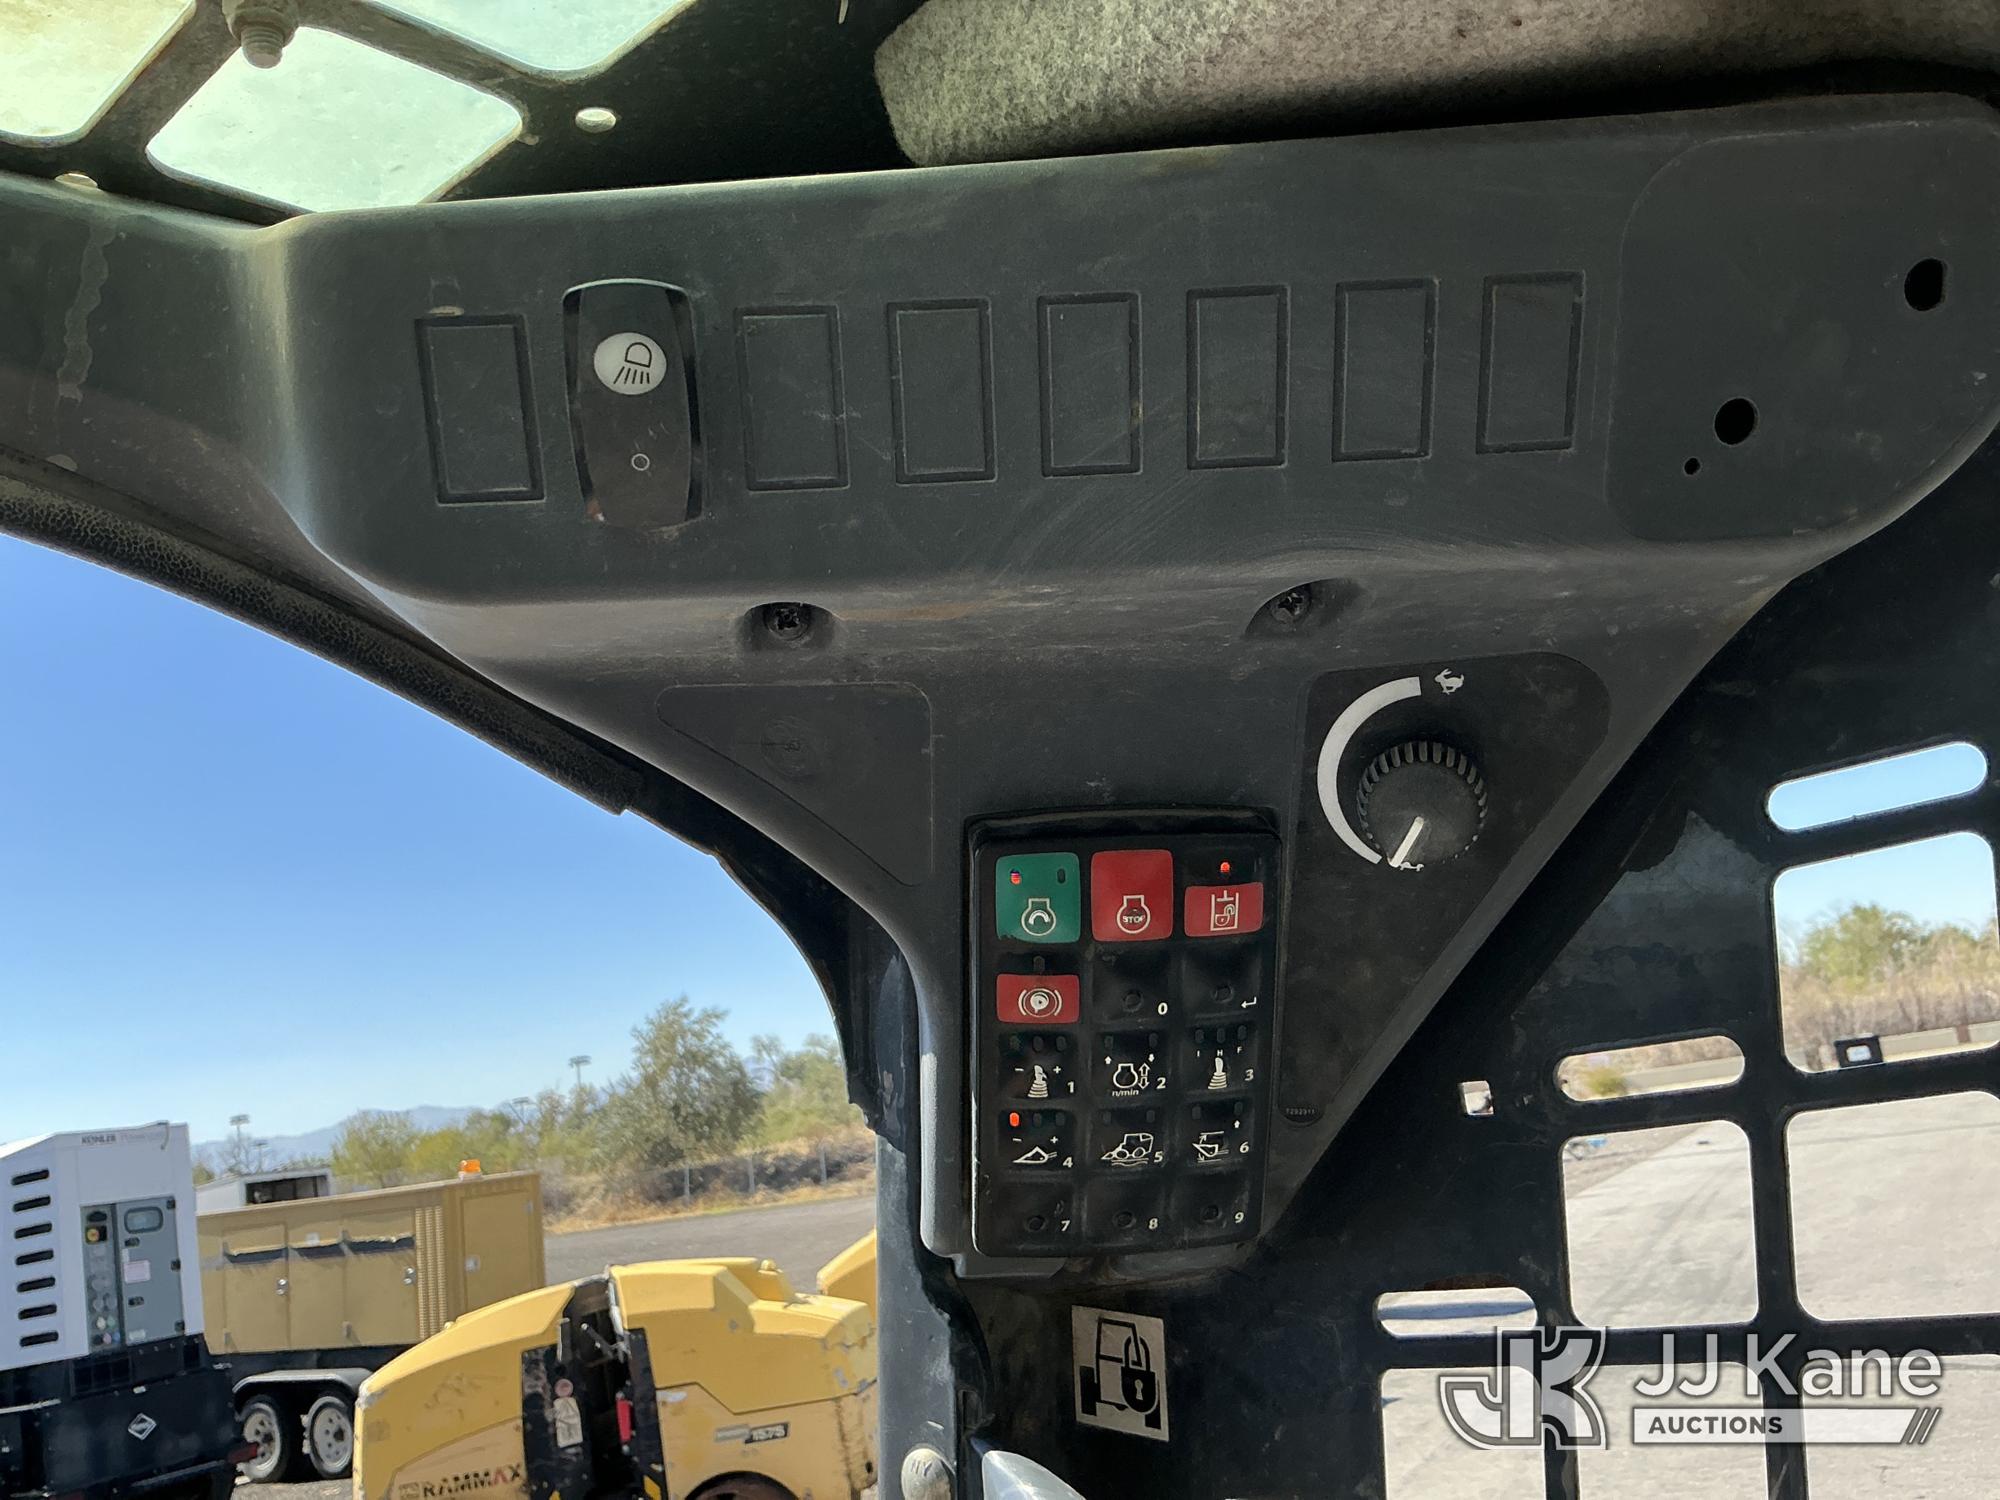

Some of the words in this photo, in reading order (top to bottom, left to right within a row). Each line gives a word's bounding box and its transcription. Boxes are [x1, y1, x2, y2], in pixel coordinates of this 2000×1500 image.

[1122, 914, 1146, 924] STOP
[1157, 1002, 1169, 1015] 0
[1244, 1068, 1254, 1081] 3
[1067, 1081, 1076, 1094] 1
[1156, 1077, 1167, 1089] 2
[1111, 1088, 1140, 1098] n/min
[1239, 1142, 1250, 1154] 6
[1062, 1157, 1074, 1169] 4
[1153, 1151, 1165, 1163] 5
[1234, 1212, 1245, 1223] 9
[1060, 1220, 1071, 1232] 7
[1148, 1218, 1159, 1230] 8
[423, 1463, 521, 1498] RAMMAX
